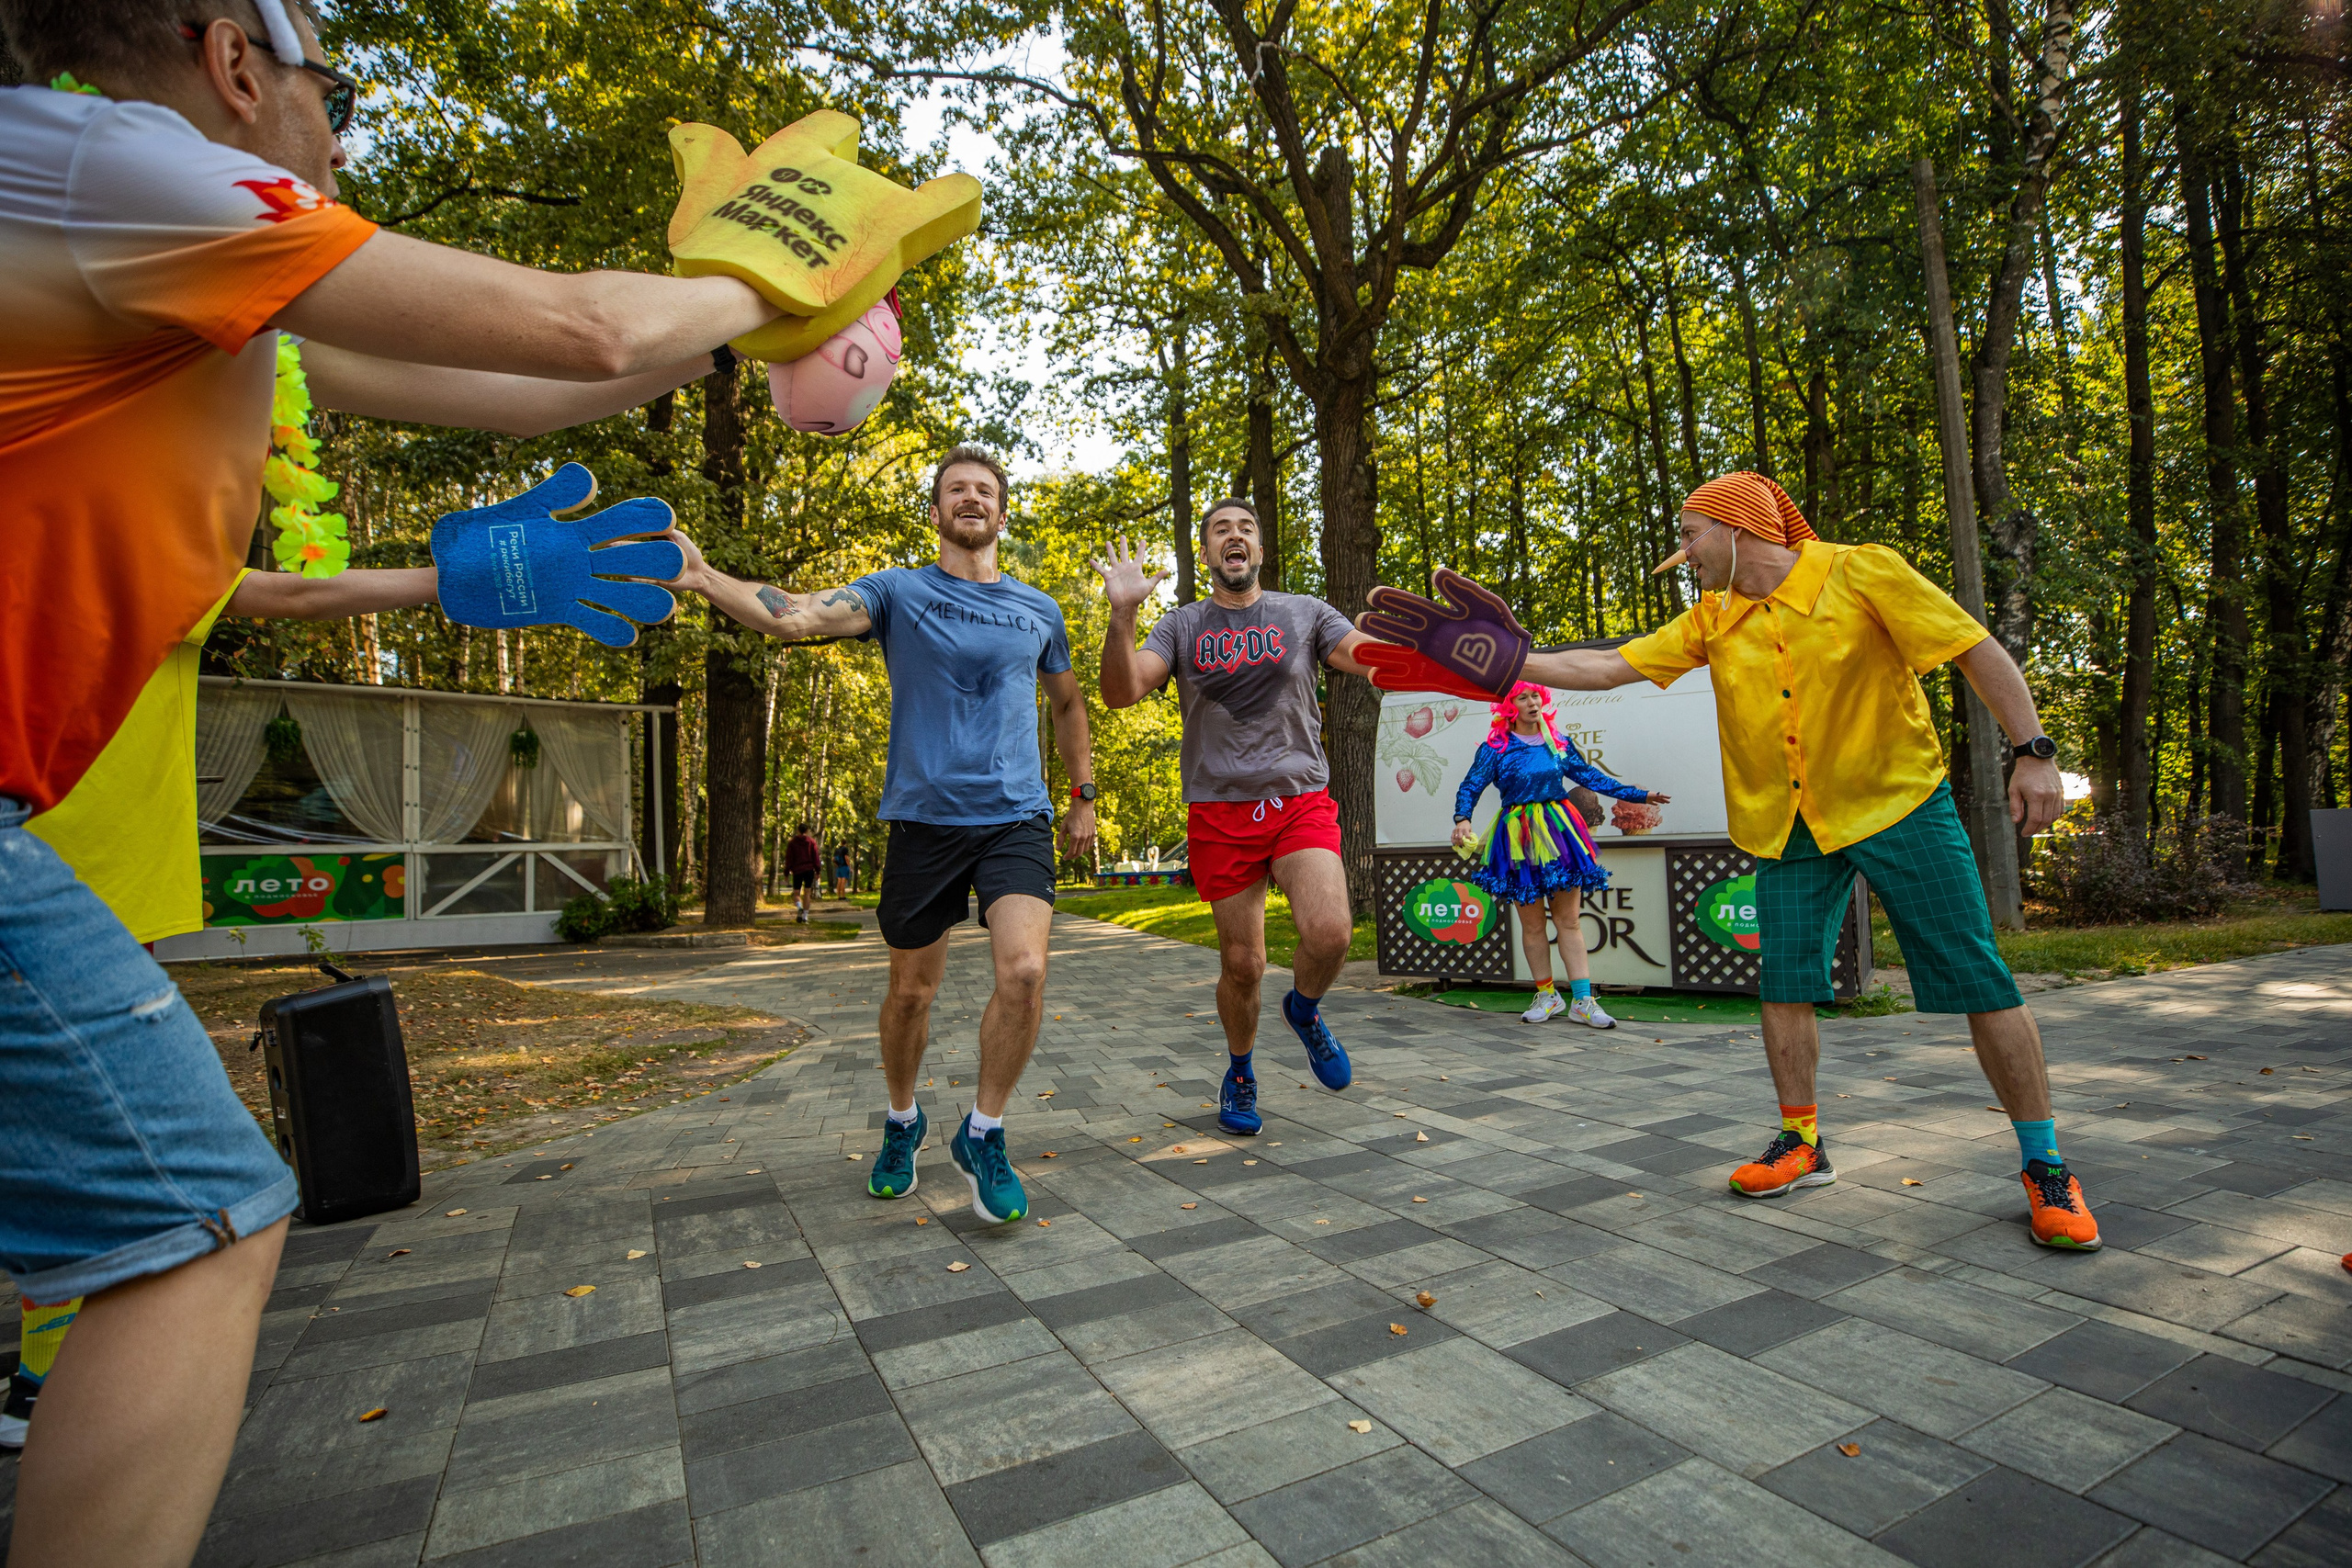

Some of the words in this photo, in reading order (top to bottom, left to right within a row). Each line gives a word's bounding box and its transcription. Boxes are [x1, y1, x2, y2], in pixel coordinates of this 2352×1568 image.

[712, 200, 830, 269] Маркет
[738, 184, 847, 252] Яндекс
[509, 531, 520, 559] Реки
[514, 562, 528, 607] России
[915, 601, 1042, 652] METALLICA
[1567, 730, 1603, 748] RTE
[1577, 888, 1634, 915] RTE
